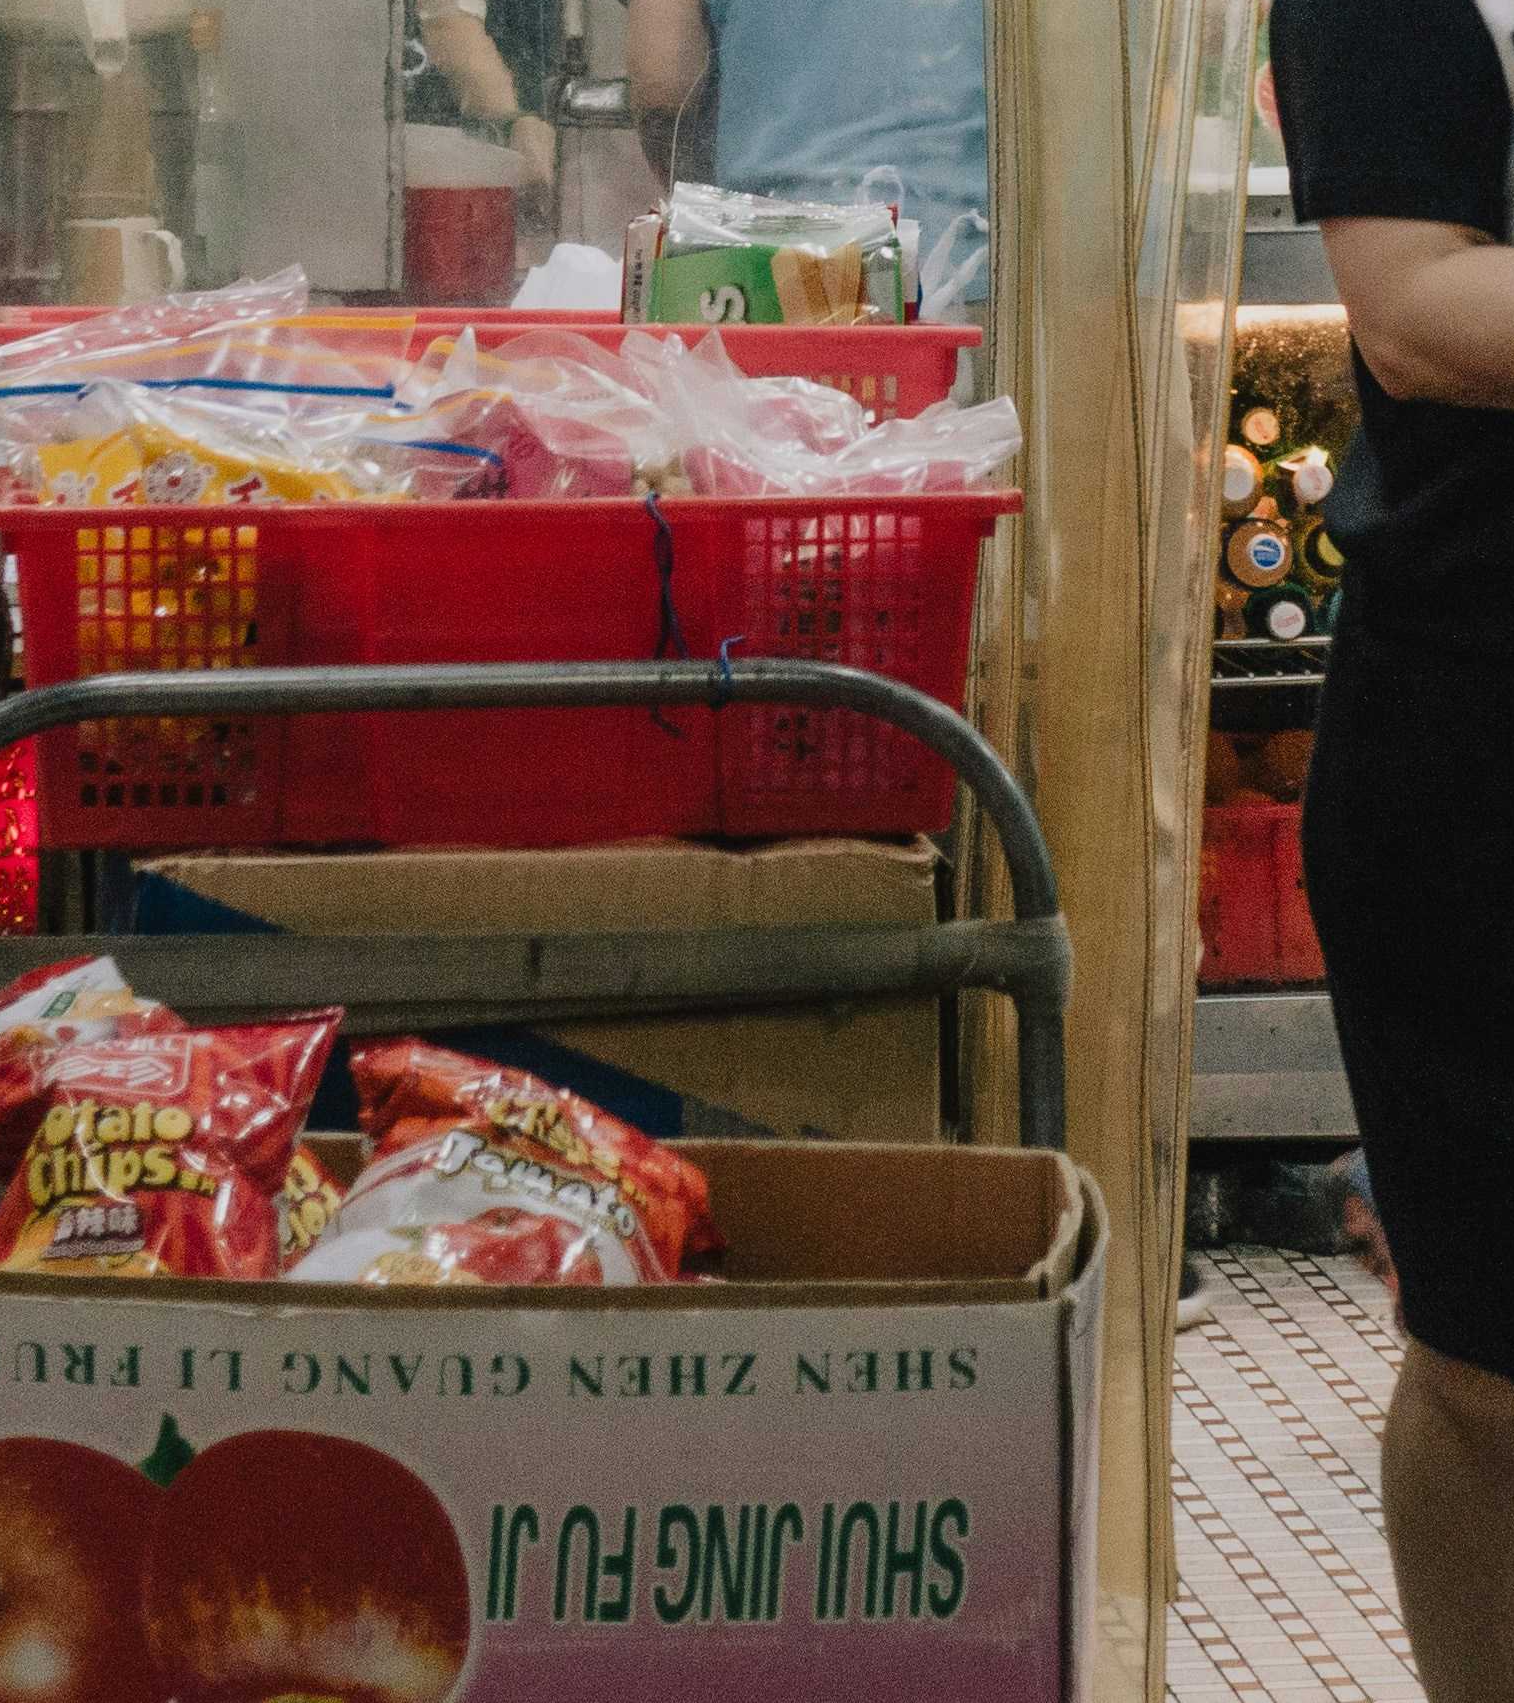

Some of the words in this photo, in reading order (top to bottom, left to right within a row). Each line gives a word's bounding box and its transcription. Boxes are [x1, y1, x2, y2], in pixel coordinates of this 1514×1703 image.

[42, 1099, 193, 1146] otato
[178, 1341, 244, 1394] LI
[285, 1351, 532, 1397] GUANG
[567, 1352, 758, 1397] ZHEN
[795, 1347, 979, 1395] SHEN
[485, 1502, 540, 1622] JI
[552, 1502, 639, 1623] FU
[653, 1501, 805, 1625] JING
[813, 1496, 970, 1621] SHUI
